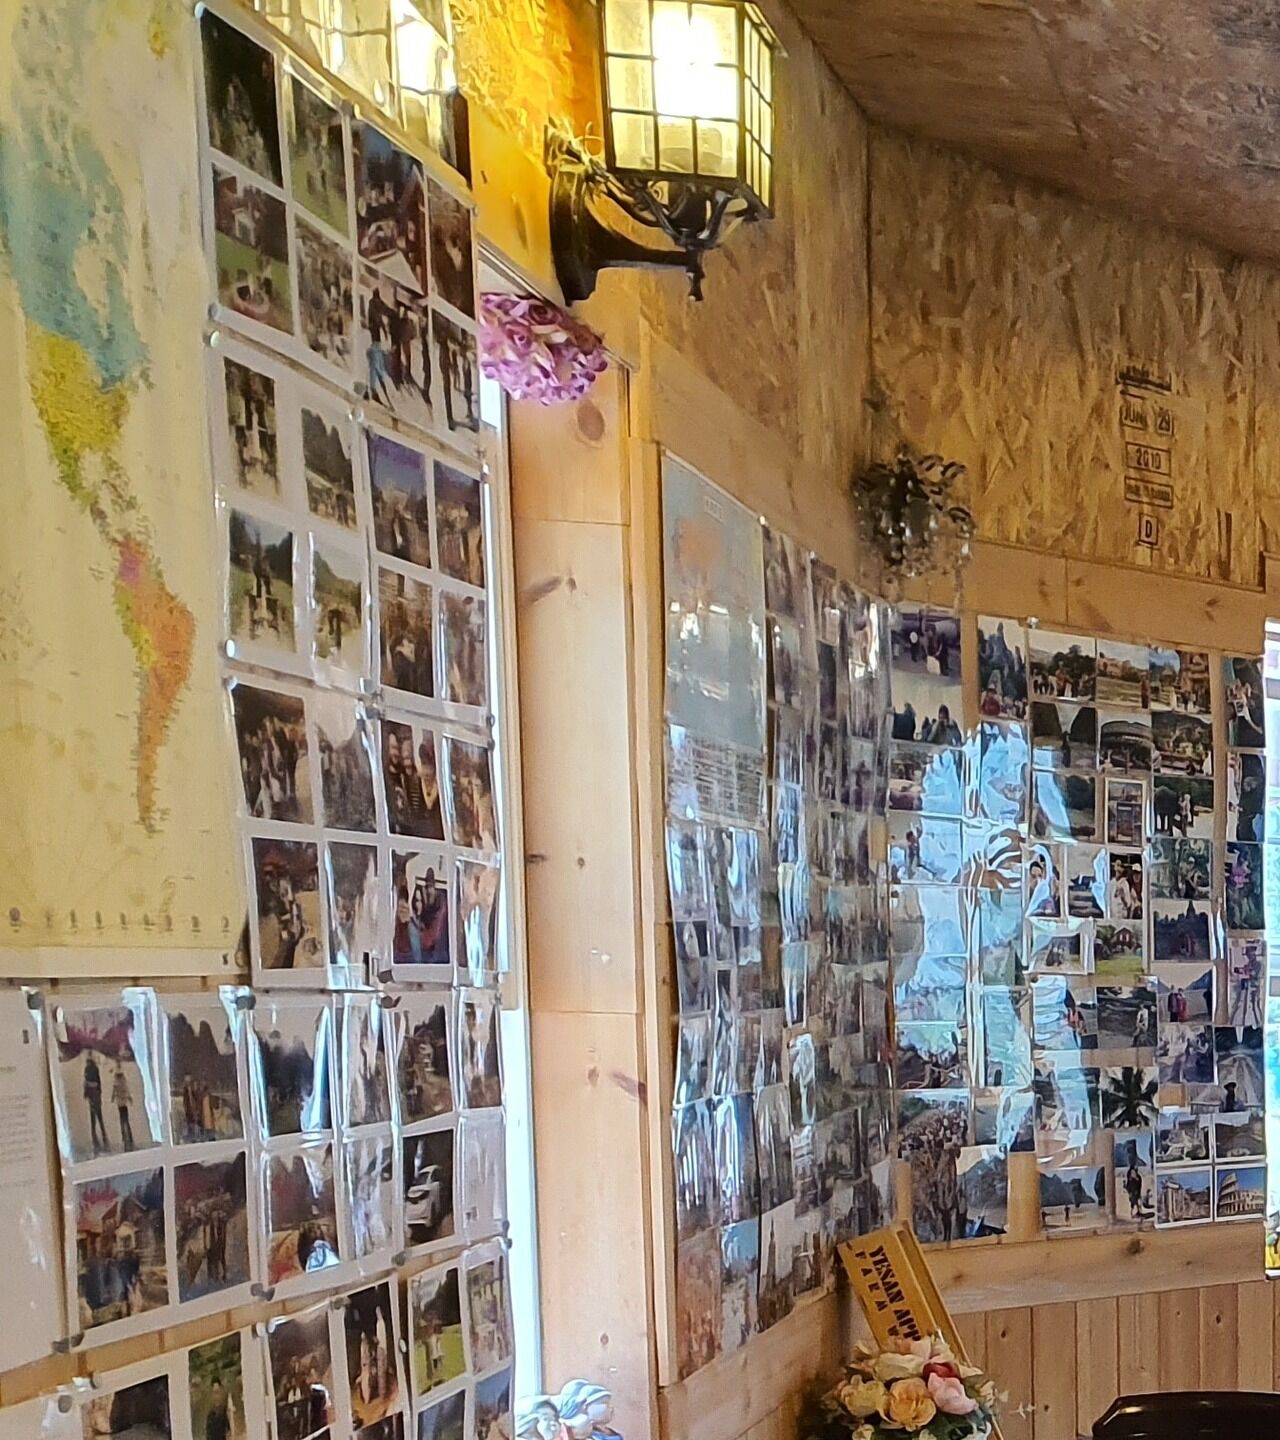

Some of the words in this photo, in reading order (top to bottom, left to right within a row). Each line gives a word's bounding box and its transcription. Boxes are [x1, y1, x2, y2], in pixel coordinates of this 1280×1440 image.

[1135, 447, 1162, 470] 2010
[1144, 519, 1153, 538] D
[855, 1250, 889, 1313] FARM
[868, 1244, 905, 1305] YESAN
[893, 1308, 922, 1342] APP
